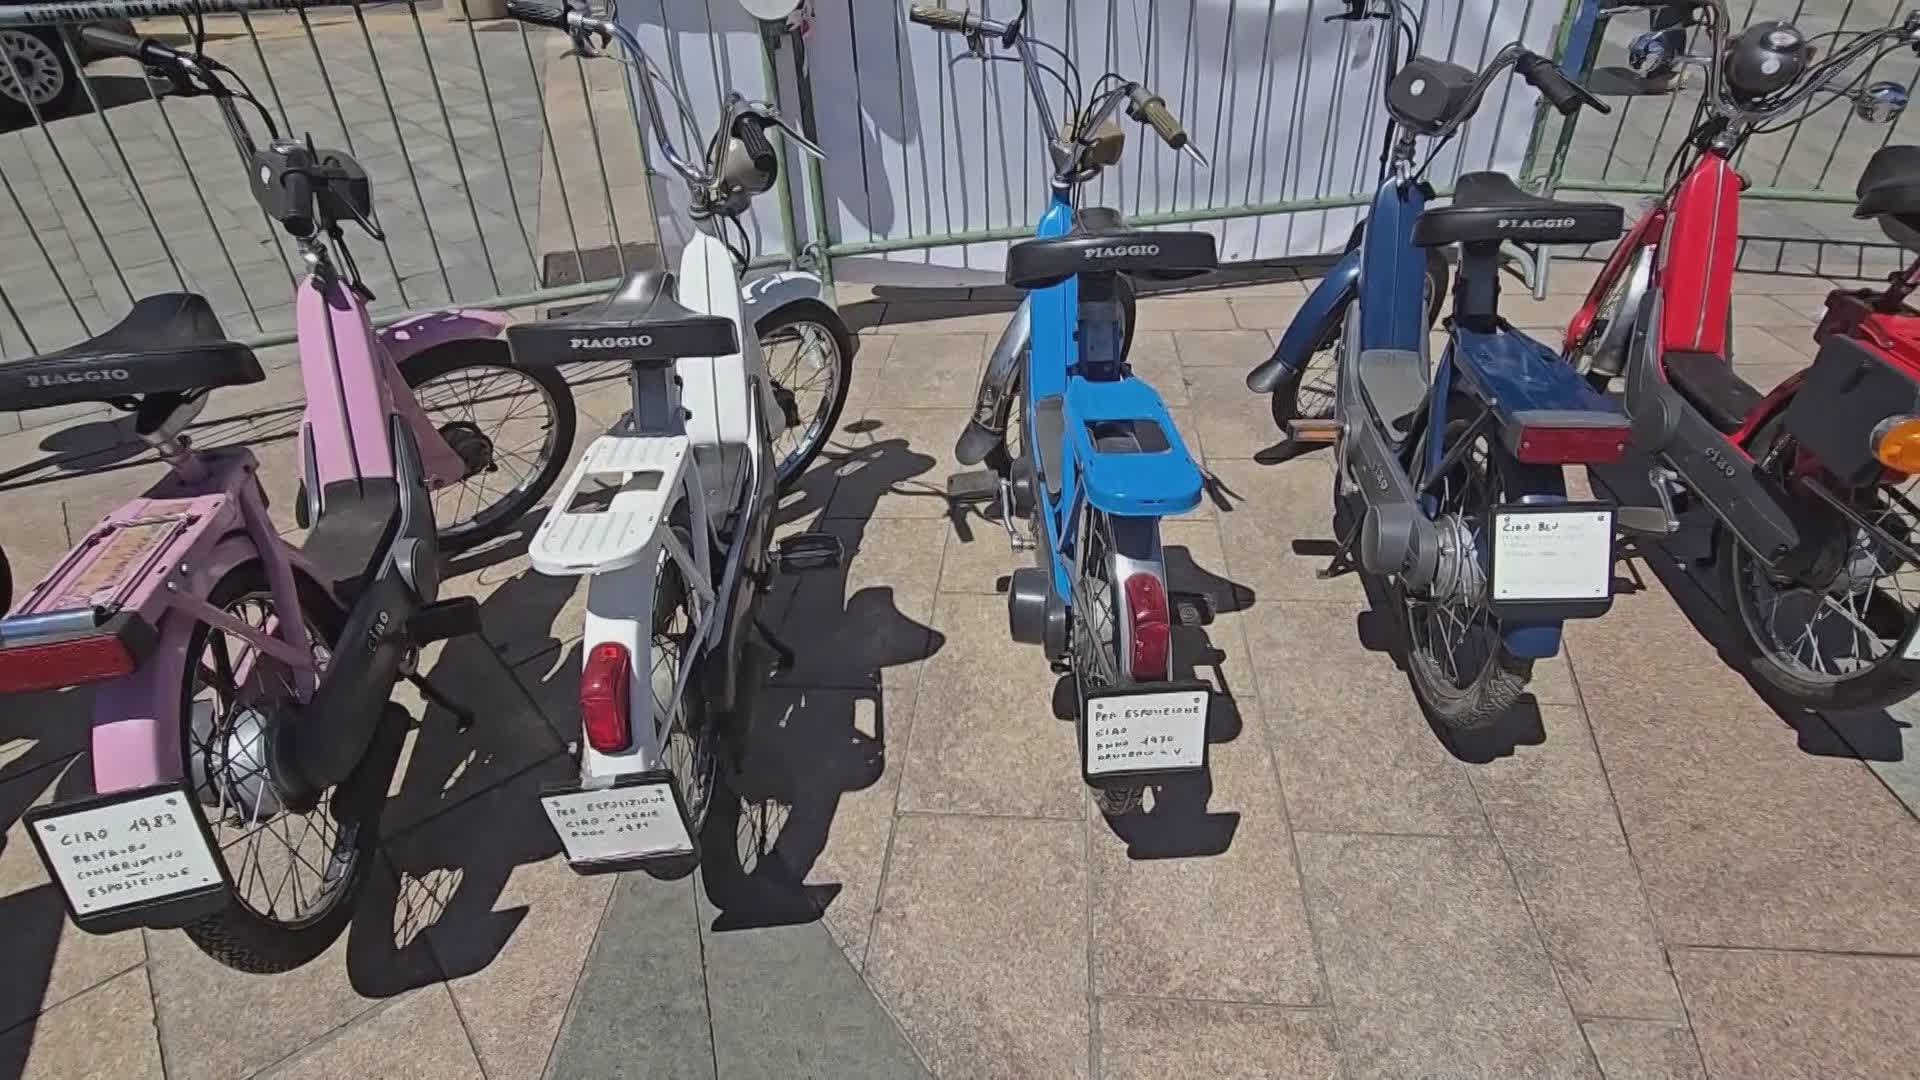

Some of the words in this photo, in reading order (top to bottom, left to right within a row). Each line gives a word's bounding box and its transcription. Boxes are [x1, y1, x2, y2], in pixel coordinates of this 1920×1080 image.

[1497, 217, 1576, 229] PIAGGIO
[1084, 244, 1160, 258] PIAGGIO
[570, 335, 652, 348] PIAGGIO
[27, 369, 129, 388] PIAGGIO
[1095, 727, 1127, 737] CIAO
[61, 829, 108, 846] CIAO
[129, 813, 177, 832] 1983
